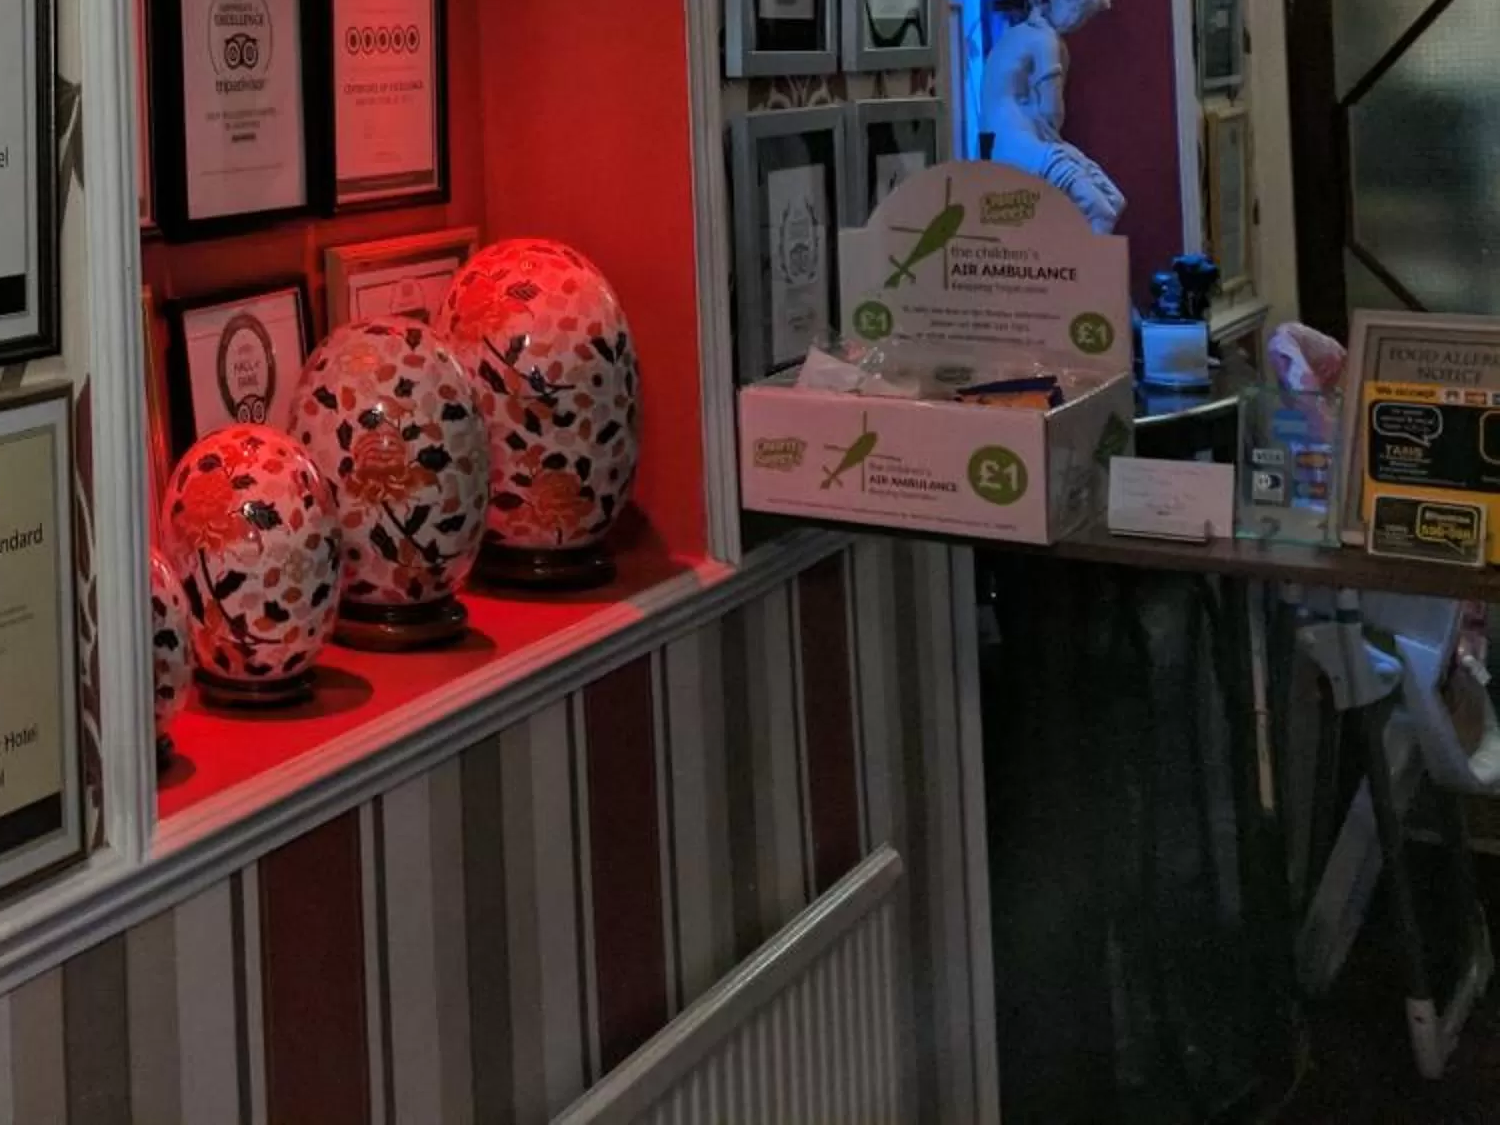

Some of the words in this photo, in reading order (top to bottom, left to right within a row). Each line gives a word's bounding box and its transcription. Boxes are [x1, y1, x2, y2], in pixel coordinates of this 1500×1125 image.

[951, 262, 978, 276] AIR
[982, 263, 1077, 282] AMBULANCE
[860, 310, 889, 332] £1
[1076, 323, 1109, 346] £1
[1389, 346, 1438, 363] FOOD
[978, 461, 1019, 493] £1
[4, 724, 39, 752] Hotel
